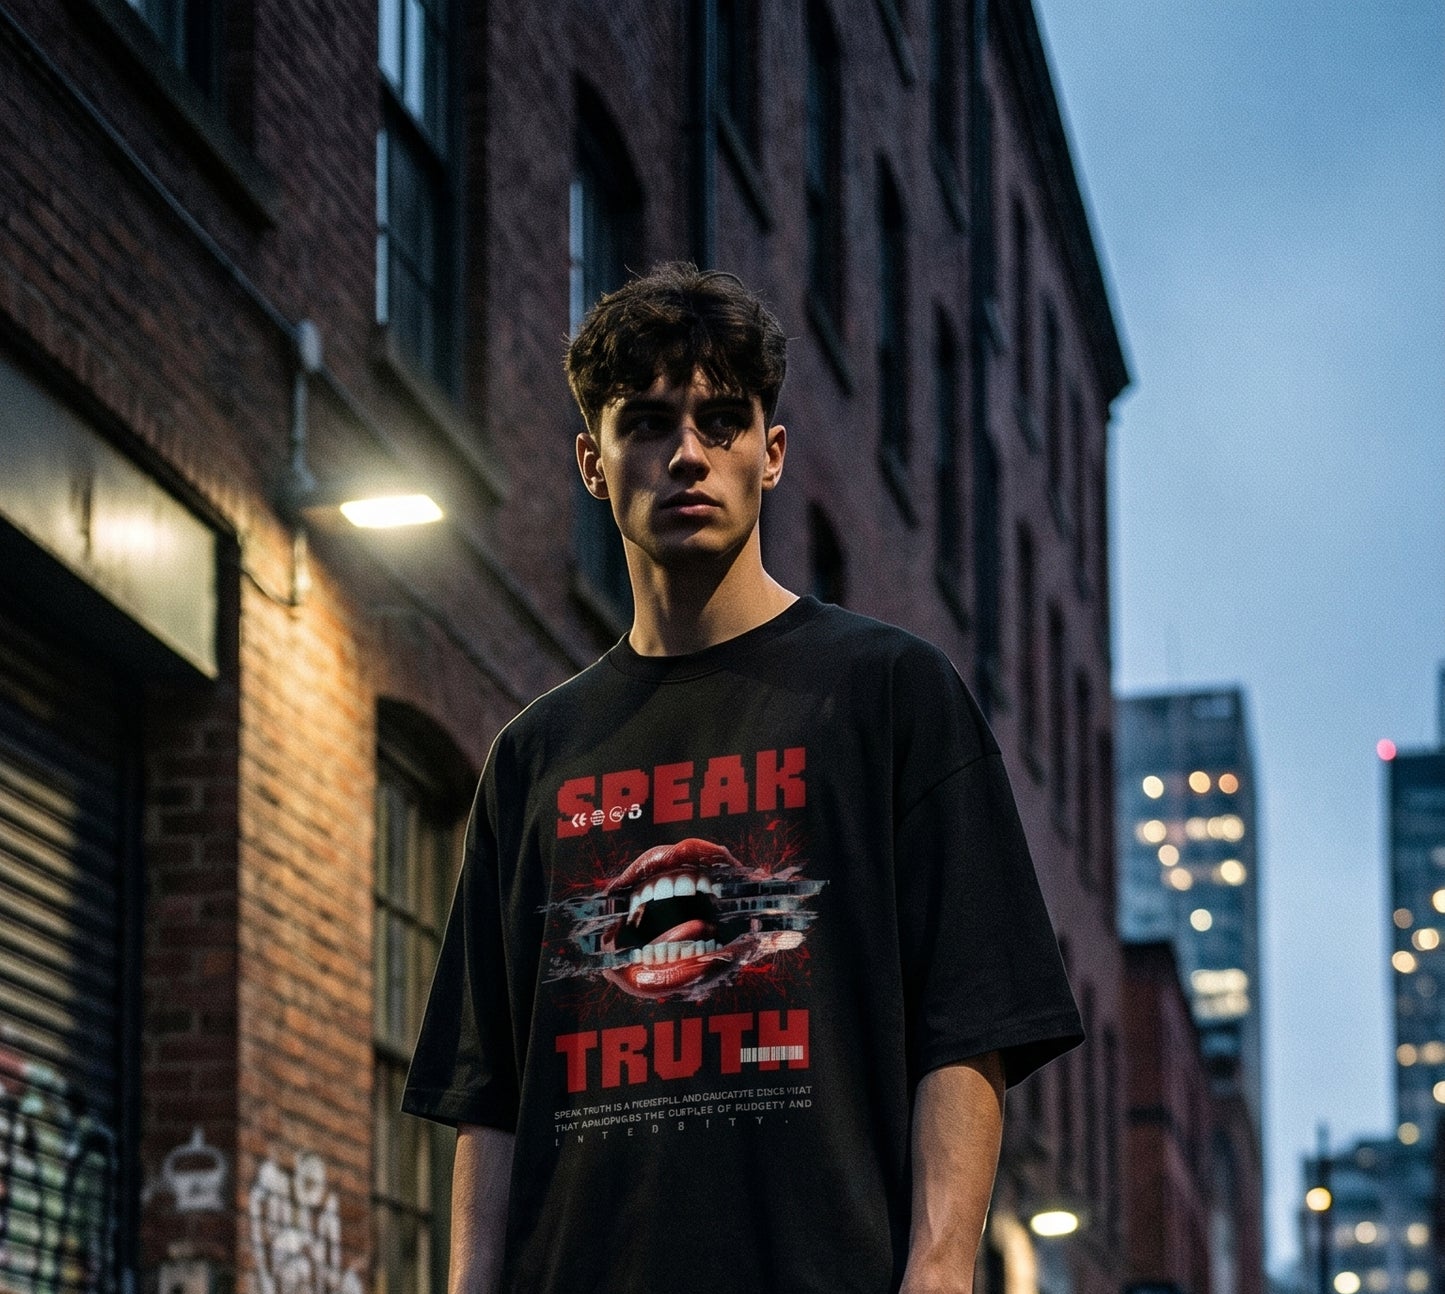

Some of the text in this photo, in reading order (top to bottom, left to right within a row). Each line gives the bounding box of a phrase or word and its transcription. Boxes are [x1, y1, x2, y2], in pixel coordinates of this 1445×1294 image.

[556, 747, 806, 839] SPEAK
[555, 1009, 810, 1094] TRUTH
[554, 1108, 582, 1121] SPEAK
[583, 1104, 612, 1115] TRUTH
[613, 1102, 623, 1112] IS
[624, 1101, 630, 1110] A
[682, 1093, 702, 1103] AND
[555, 1121, 579, 1133] THAT
[644, 1110, 665, 1121] THE
[717, 1104, 732, 1113] OF
[789, 1099, 812, 1108] AND
